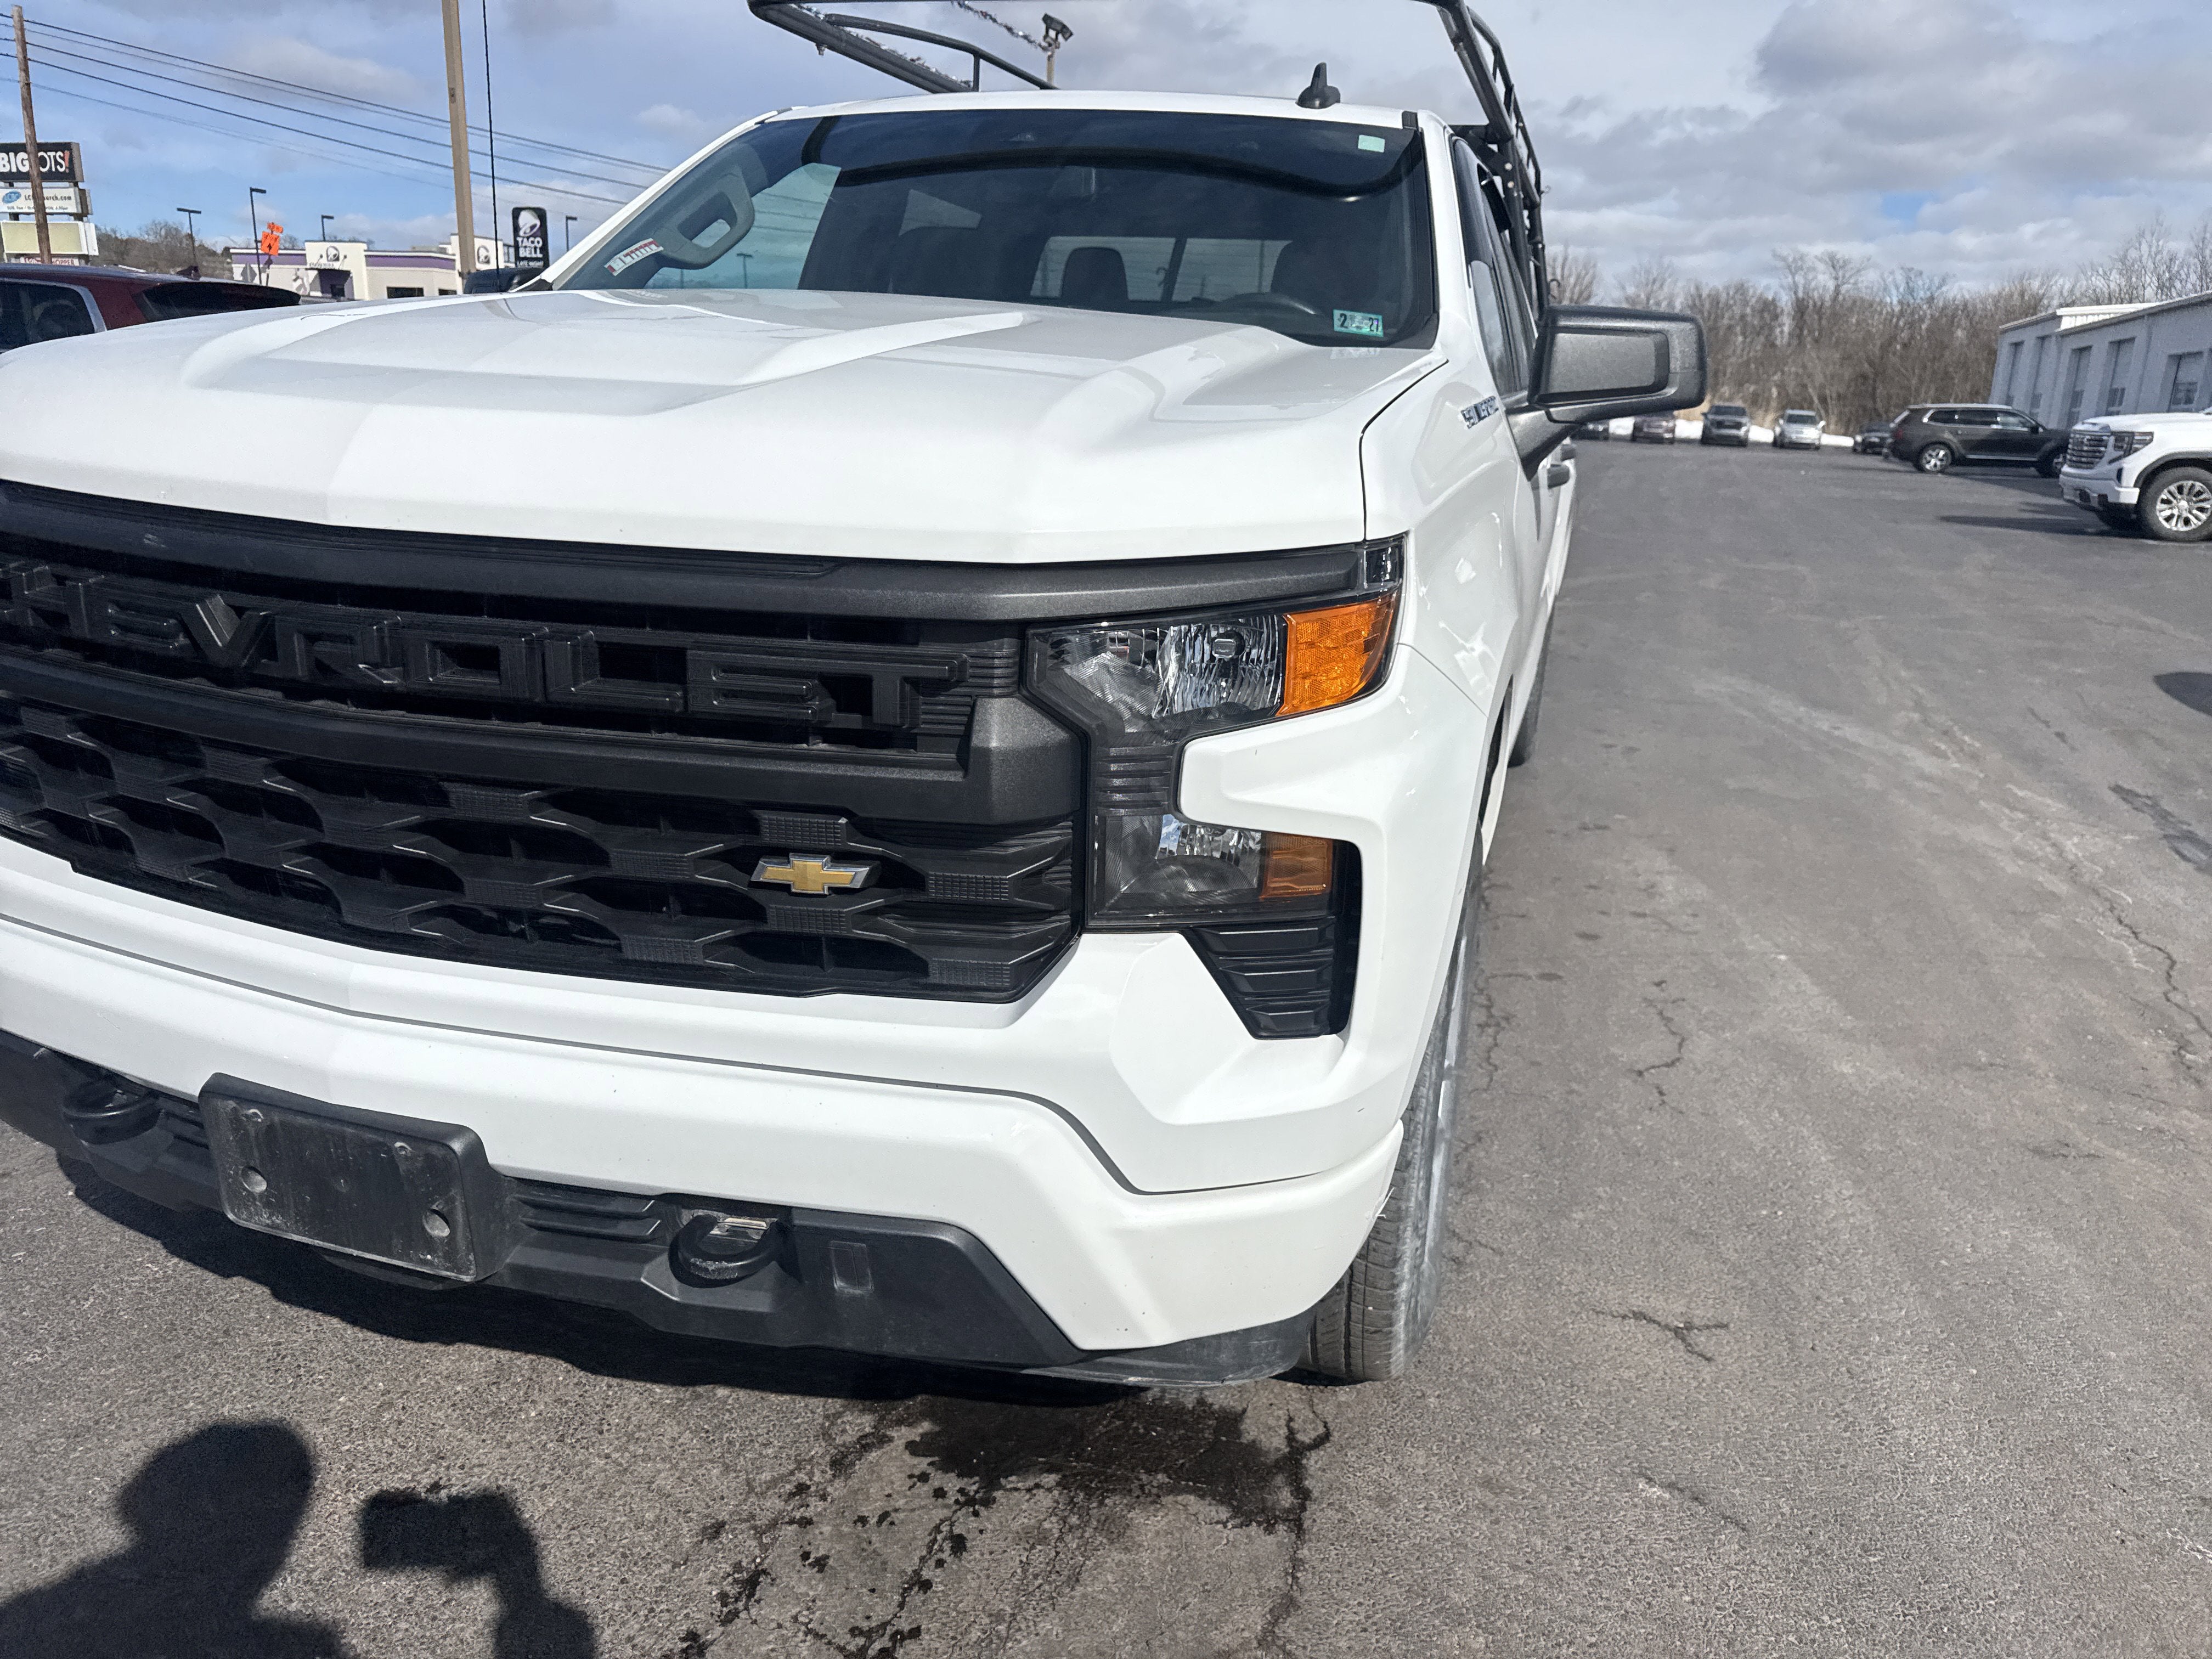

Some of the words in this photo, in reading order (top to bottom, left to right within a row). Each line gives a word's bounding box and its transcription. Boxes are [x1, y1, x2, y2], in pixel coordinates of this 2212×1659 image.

[0, 152, 30, 173] BIG
[38, 150, 70, 173] OTS!
[516, 237, 543, 247] TACO
[519, 247, 543, 257] BELL
[1340, 313, 1348, 329] 2
[1369, 317, 1379, 332] 27
[0, 561, 967, 727] HEVROLET
